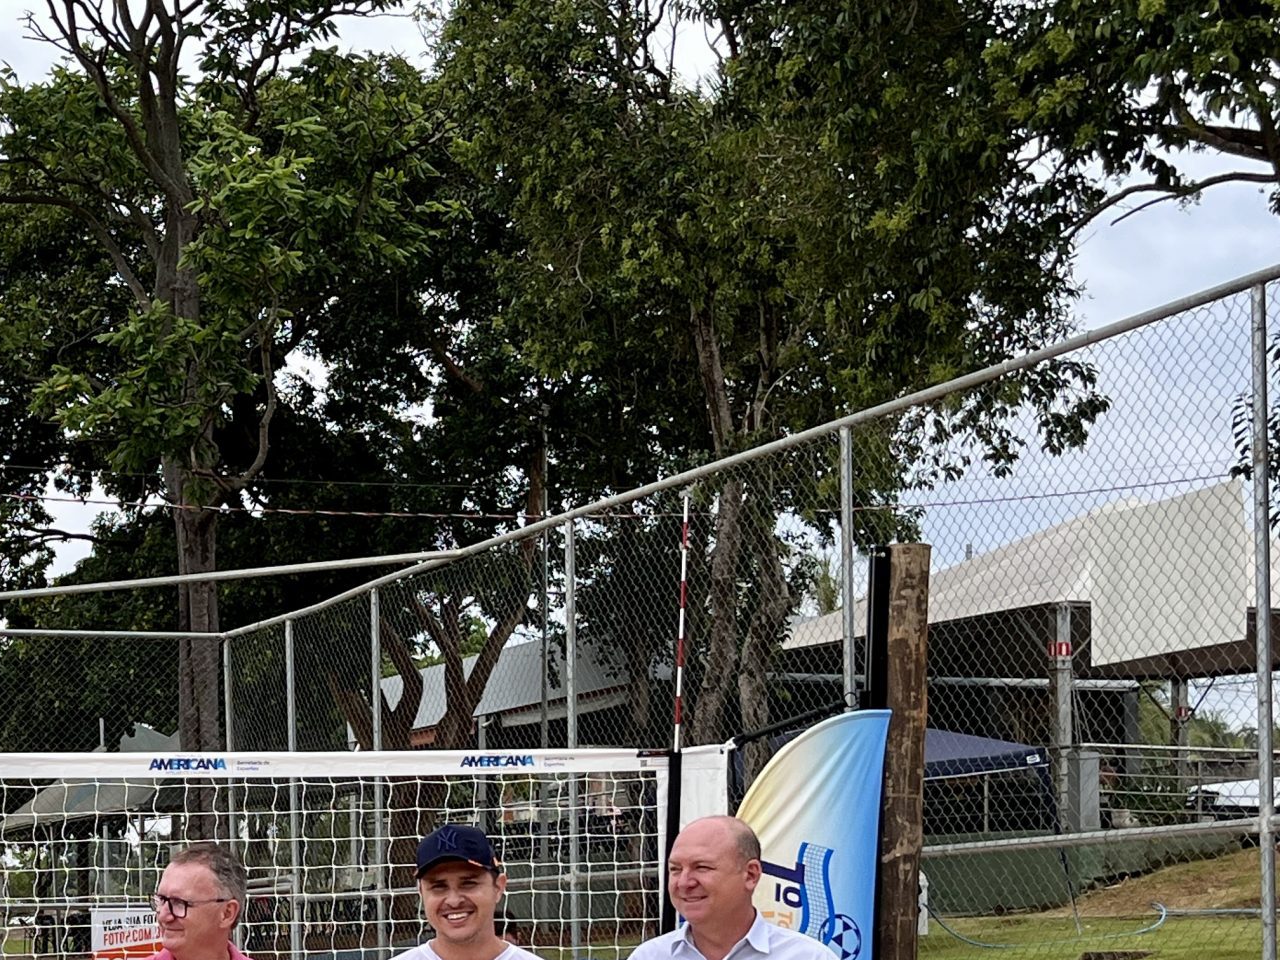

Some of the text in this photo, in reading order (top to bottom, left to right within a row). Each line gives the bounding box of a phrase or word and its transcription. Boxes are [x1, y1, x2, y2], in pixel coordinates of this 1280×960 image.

[149, 758, 227, 771] AMERICANA
[460, 755, 535, 768] AMERICANA
[437, 828, 457, 850] NY
